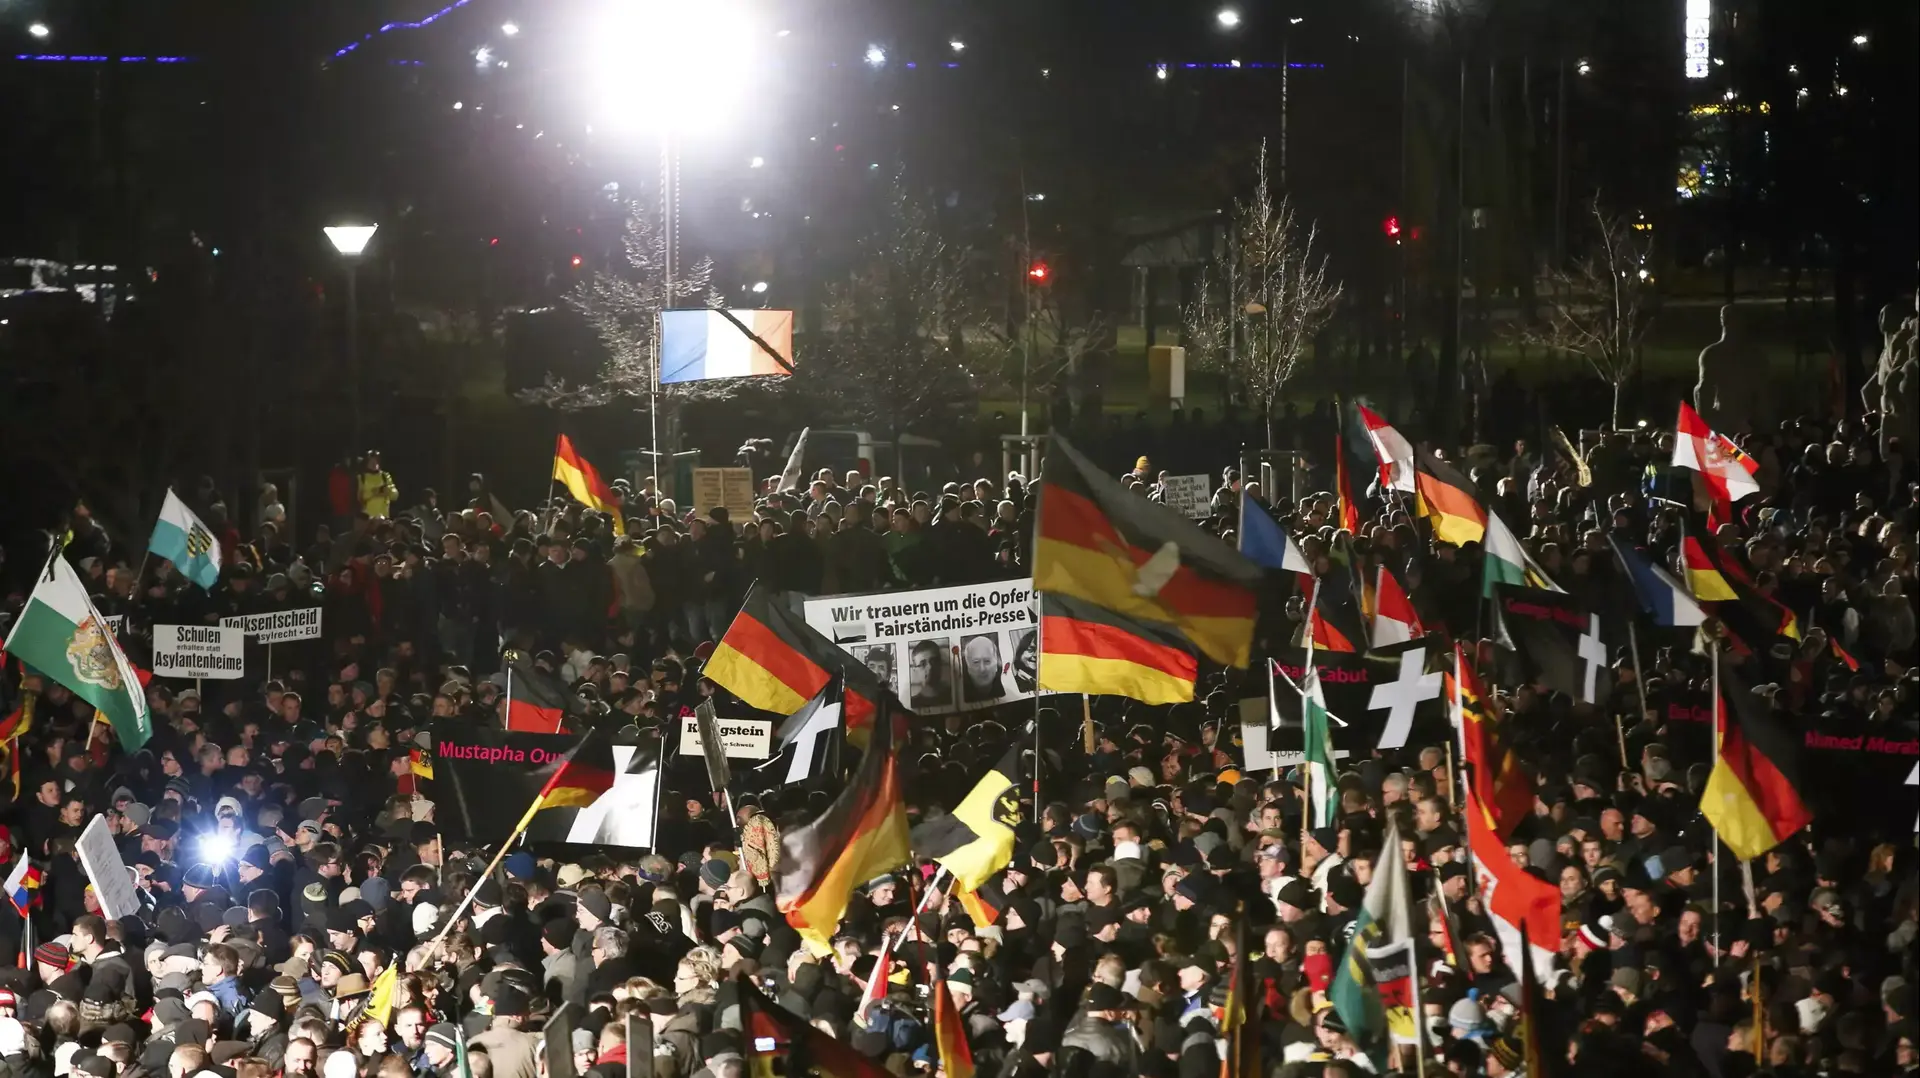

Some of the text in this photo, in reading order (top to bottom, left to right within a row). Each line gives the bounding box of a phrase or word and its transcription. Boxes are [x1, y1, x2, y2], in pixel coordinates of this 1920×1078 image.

[831, 606, 863, 623] Wir
[866, 602, 930, 620] trauern
[934, 599, 959, 613] um
[962, 593, 986, 610] die
[989, 588, 1030, 609] Opfer
[305, 626, 318, 636] EU
[874, 607, 1026, 638] Fairständnis-Presse
[177, 626, 221, 644] Schulen
[154, 651, 242, 671] Asylantenheime
[188, 670, 209, 678] bauen
[1318, 665, 1368, 684] Cabut
[687, 722, 764, 737] Kgstein
[1804, 729, 1864, 751] Ahmed
[438, 740, 525, 765] Mustapha
